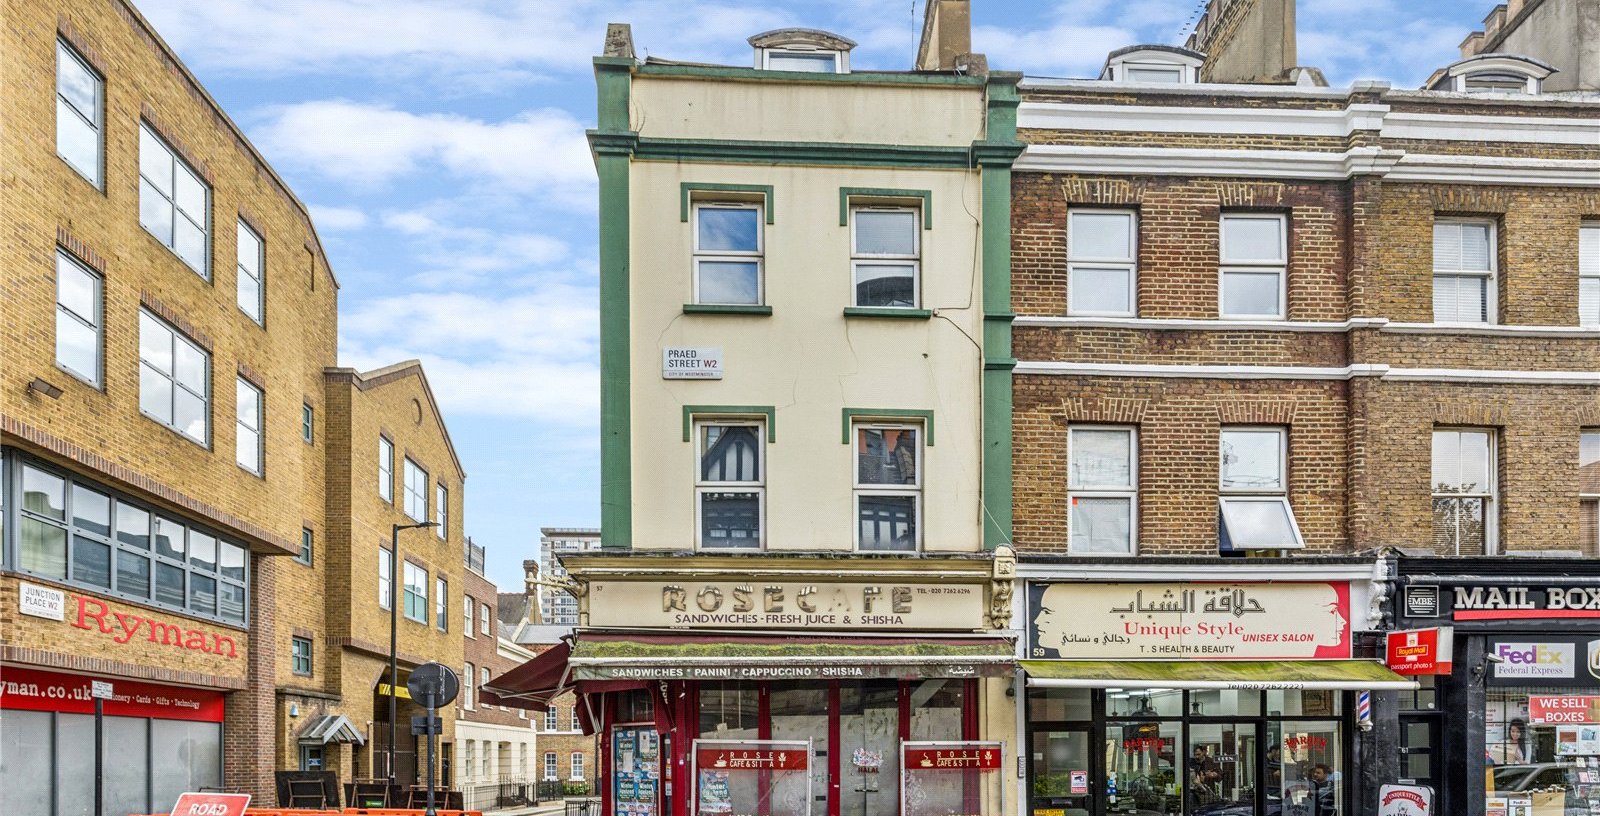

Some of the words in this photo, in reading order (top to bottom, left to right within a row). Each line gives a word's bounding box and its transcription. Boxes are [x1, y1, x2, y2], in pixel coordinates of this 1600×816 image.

[668, 349, 697, 358] PRAED
[668, 359, 701, 368] STREET
[703, 359, 717, 368] W2
[25, 587, 60, 602] JUNCTION
[1453, 587, 1536, 610] MAIL
[25, 596, 47, 608] PLACE
[48, 600, 58, 611] W2
[1109, 589, 1195, 619] الشباب
[1202, 587, 1266, 618] حلاقة
[1411, 597, 1434, 606] MBE
[675, 614, 758, 624] SANDWICHES
[765, 614, 802, 624] FRESH
[805, 614, 836, 626] JUICE
[842, 615, 852, 624] &
[861, 615, 904, 625] SHISHA
[70, 594, 239, 658] Ryman
[1124, 621, 1192, 640] Unique
[1197, 621, 1244, 640] Style
[1242, 633, 1279, 642] UNISEX
[1281, 633, 1314, 642] SALON
[1033, 648, 1046, 657] 59
[1159, 645, 1191, 653] HEALTH
[1193, 645, 1200, 653] &
[1202, 645, 1235, 653] BEAUTY
[1398, 647, 1413, 656] Royal
[1413, 646, 1426, 654] Mail
[1499, 644, 1563, 665] FedEx
[612, 668, 684, 677] SANDWICHES
[694, 668, 731, 677] PANINI
[742, 667, 812, 677] CAPPUCCINO
[822, 667, 863, 676] SHISHA
[948, 665, 975, 677] شيشة
[1498, 665, 1529, 674] Federal
[1531, 665, 1563, 676] Express
[136, 694, 151, 704] Cards
[156, 696, 170, 706] Gifts
[174, 698, 200, 710] Technology
[1540, 698, 1560, 708] WE
[1561, 698, 1588, 708] SELL
[1545, 712, 1585, 722] BOXES
[729, 760, 745, 768] CAFE
[936, 759, 952, 767] CAFE
[188, 803, 228, 816] ROAD
